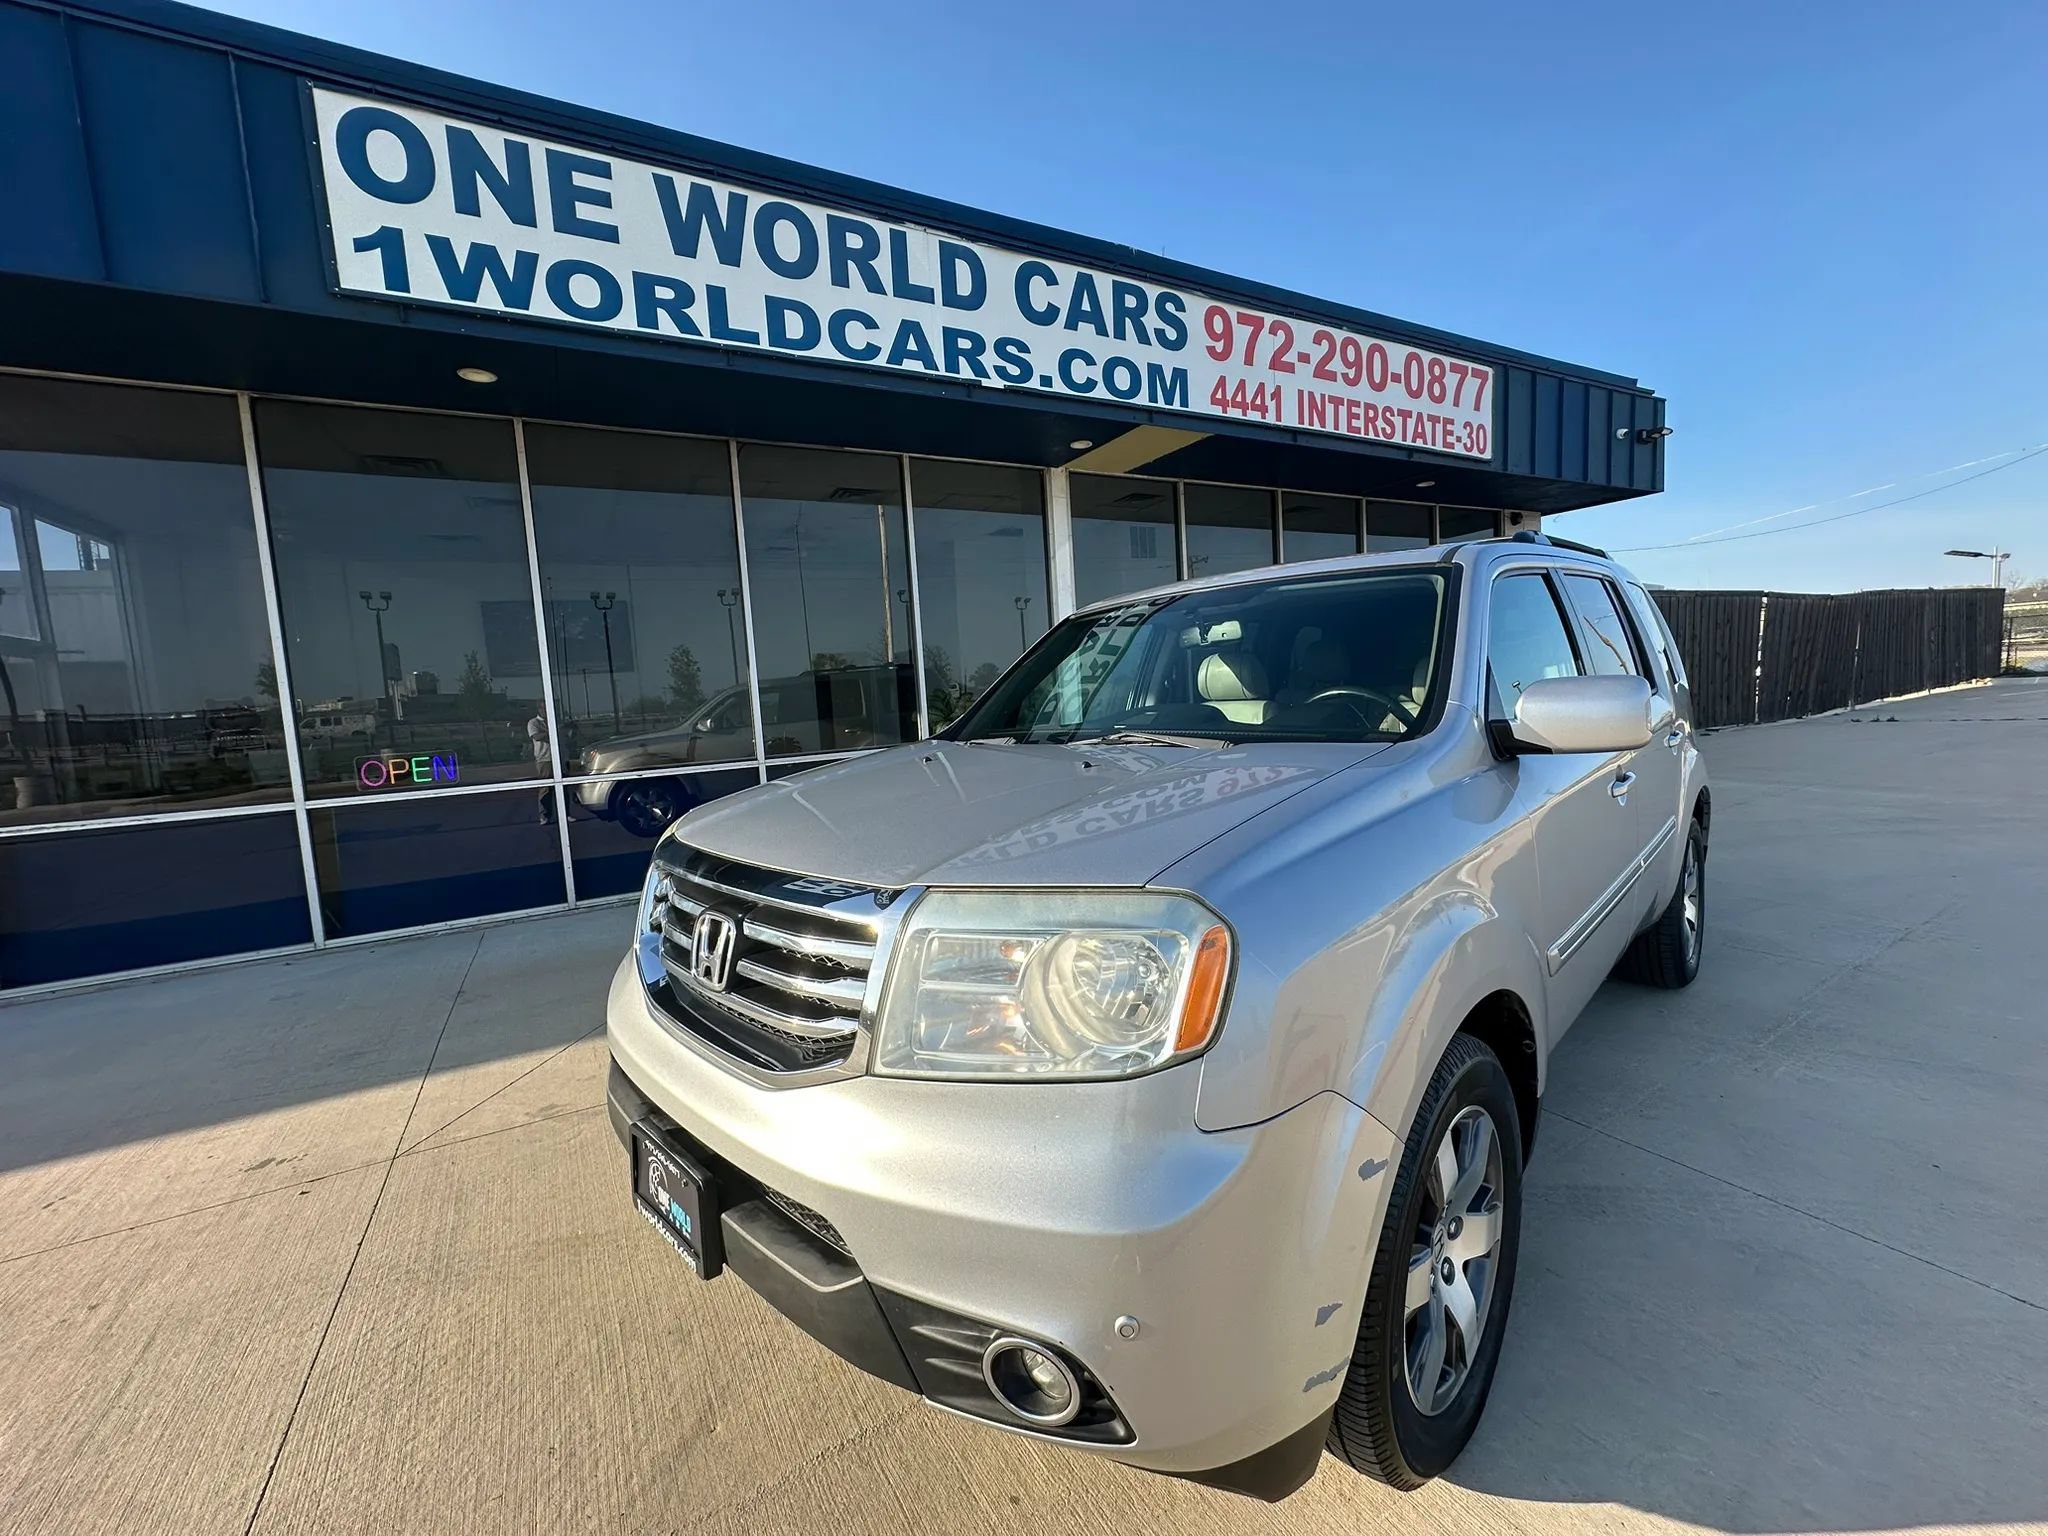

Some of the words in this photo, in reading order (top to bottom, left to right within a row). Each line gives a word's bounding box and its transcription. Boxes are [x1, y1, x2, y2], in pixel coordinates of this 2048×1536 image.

[336, 106, 621, 245] ONE
[652, 171, 988, 312] WORLD
[1014, 260, 1189, 352] CARS
[352, 224, 1191, 409] 1WORLDCARS.COM
[1204, 305, 1490, 413] 972-290-0877
[1210, 376, 1284, 423] 4441
[1297, 388, 1488, 455] INTERSTATE-30
[361, 755, 457, 787] OPEN
